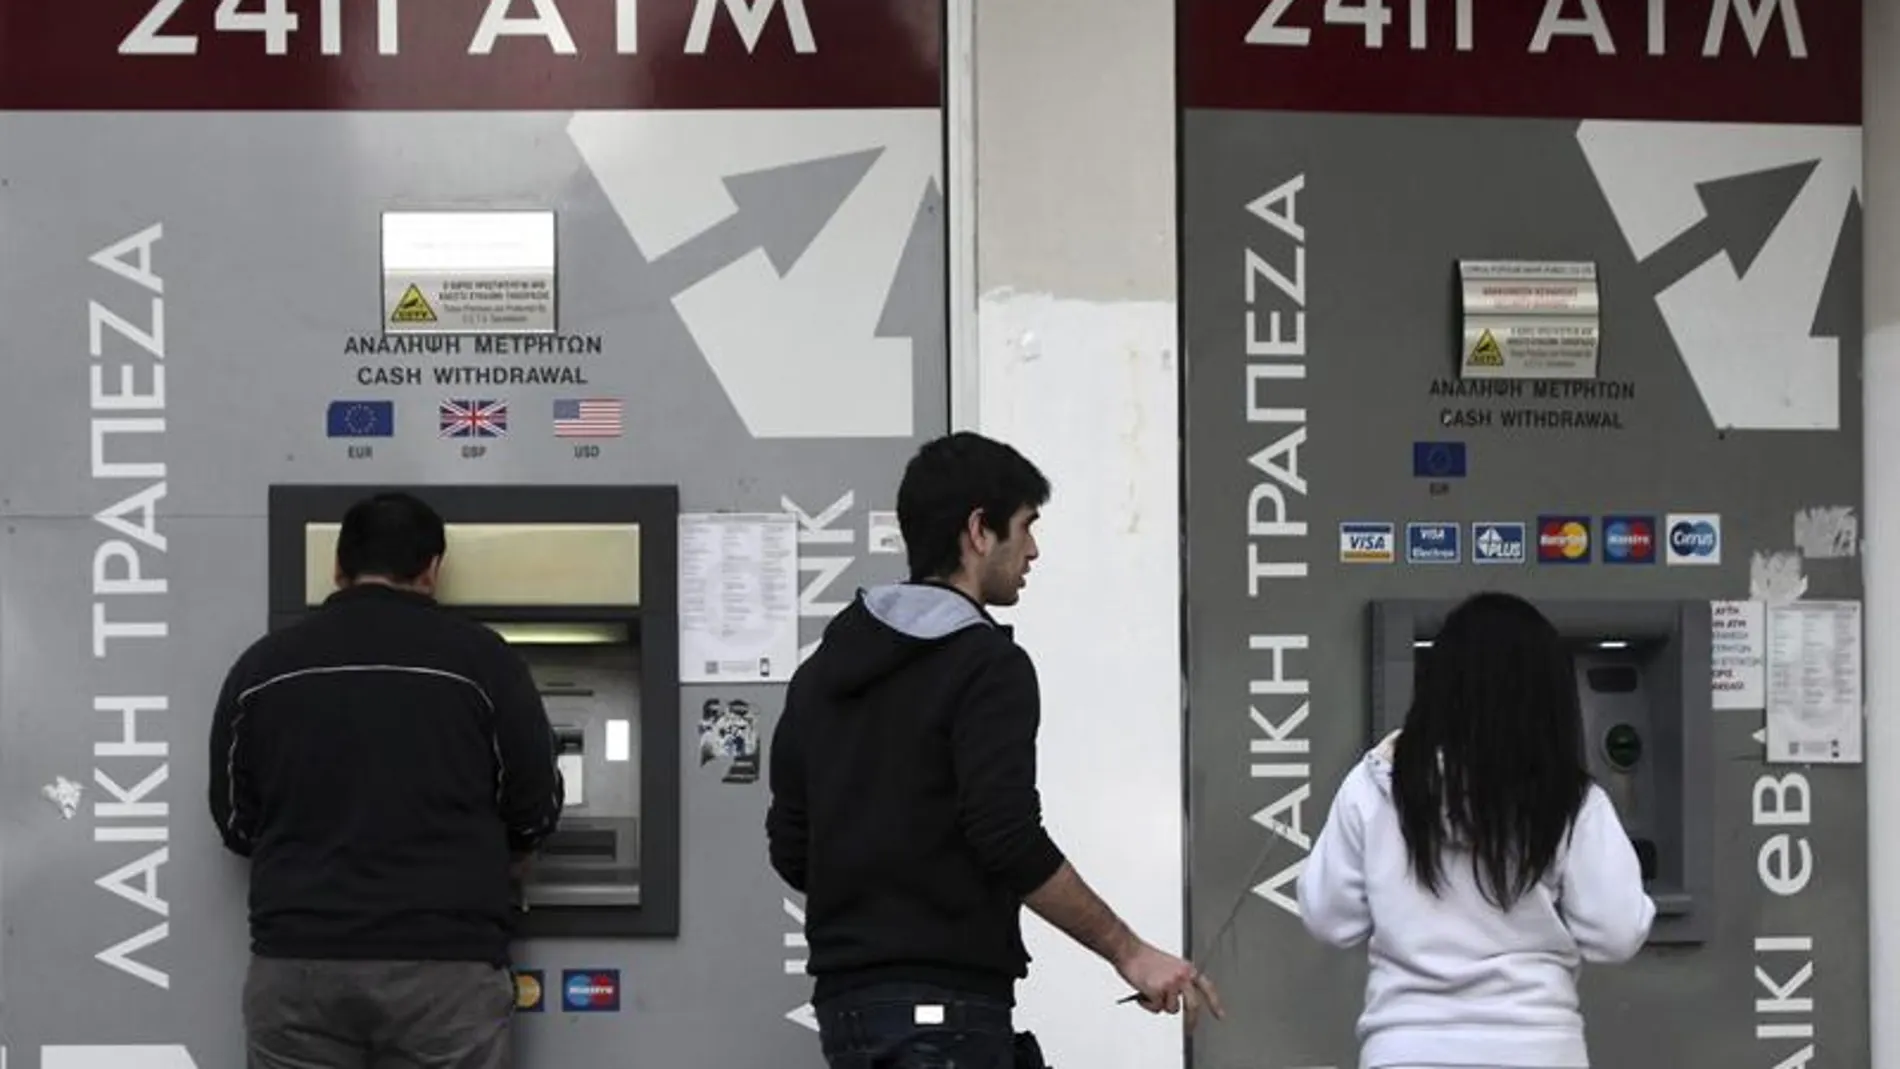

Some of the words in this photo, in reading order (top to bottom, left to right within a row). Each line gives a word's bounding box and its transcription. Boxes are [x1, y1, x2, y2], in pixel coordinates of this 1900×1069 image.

[344, 336, 460, 354] ΑΝΑΛΗΨΗ
[475, 336, 602, 354] ΜΕΤΡΗΤΩΝ
[357, 367, 421, 385] CASH
[434, 367, 588, 385] WITHDRAWAL
[1245, 174, 1308, 597] ΤΡΑΠΕΖΑ
[1532, 379, 1635, 400] ΜΕΤΡΗΤΩΝ
[1440, 408, 1492, 428] CASH
[1500, 409, 1622, 430] WITHDRAWAL
[89, 223, 168, 658] ΤΡΑΠΕΖΑ
[348, 446, 373, 459] EUR
[462, 446, 486, 459] GBP
[574, 446, 600, 459] USD
[1350, 536, 1385, 549] VISA
[1420, 529, 1445, 540] VISA
[1673, 531, 1714, 545] Cirrus
[1490, 541, 1521, 557] PLUS
